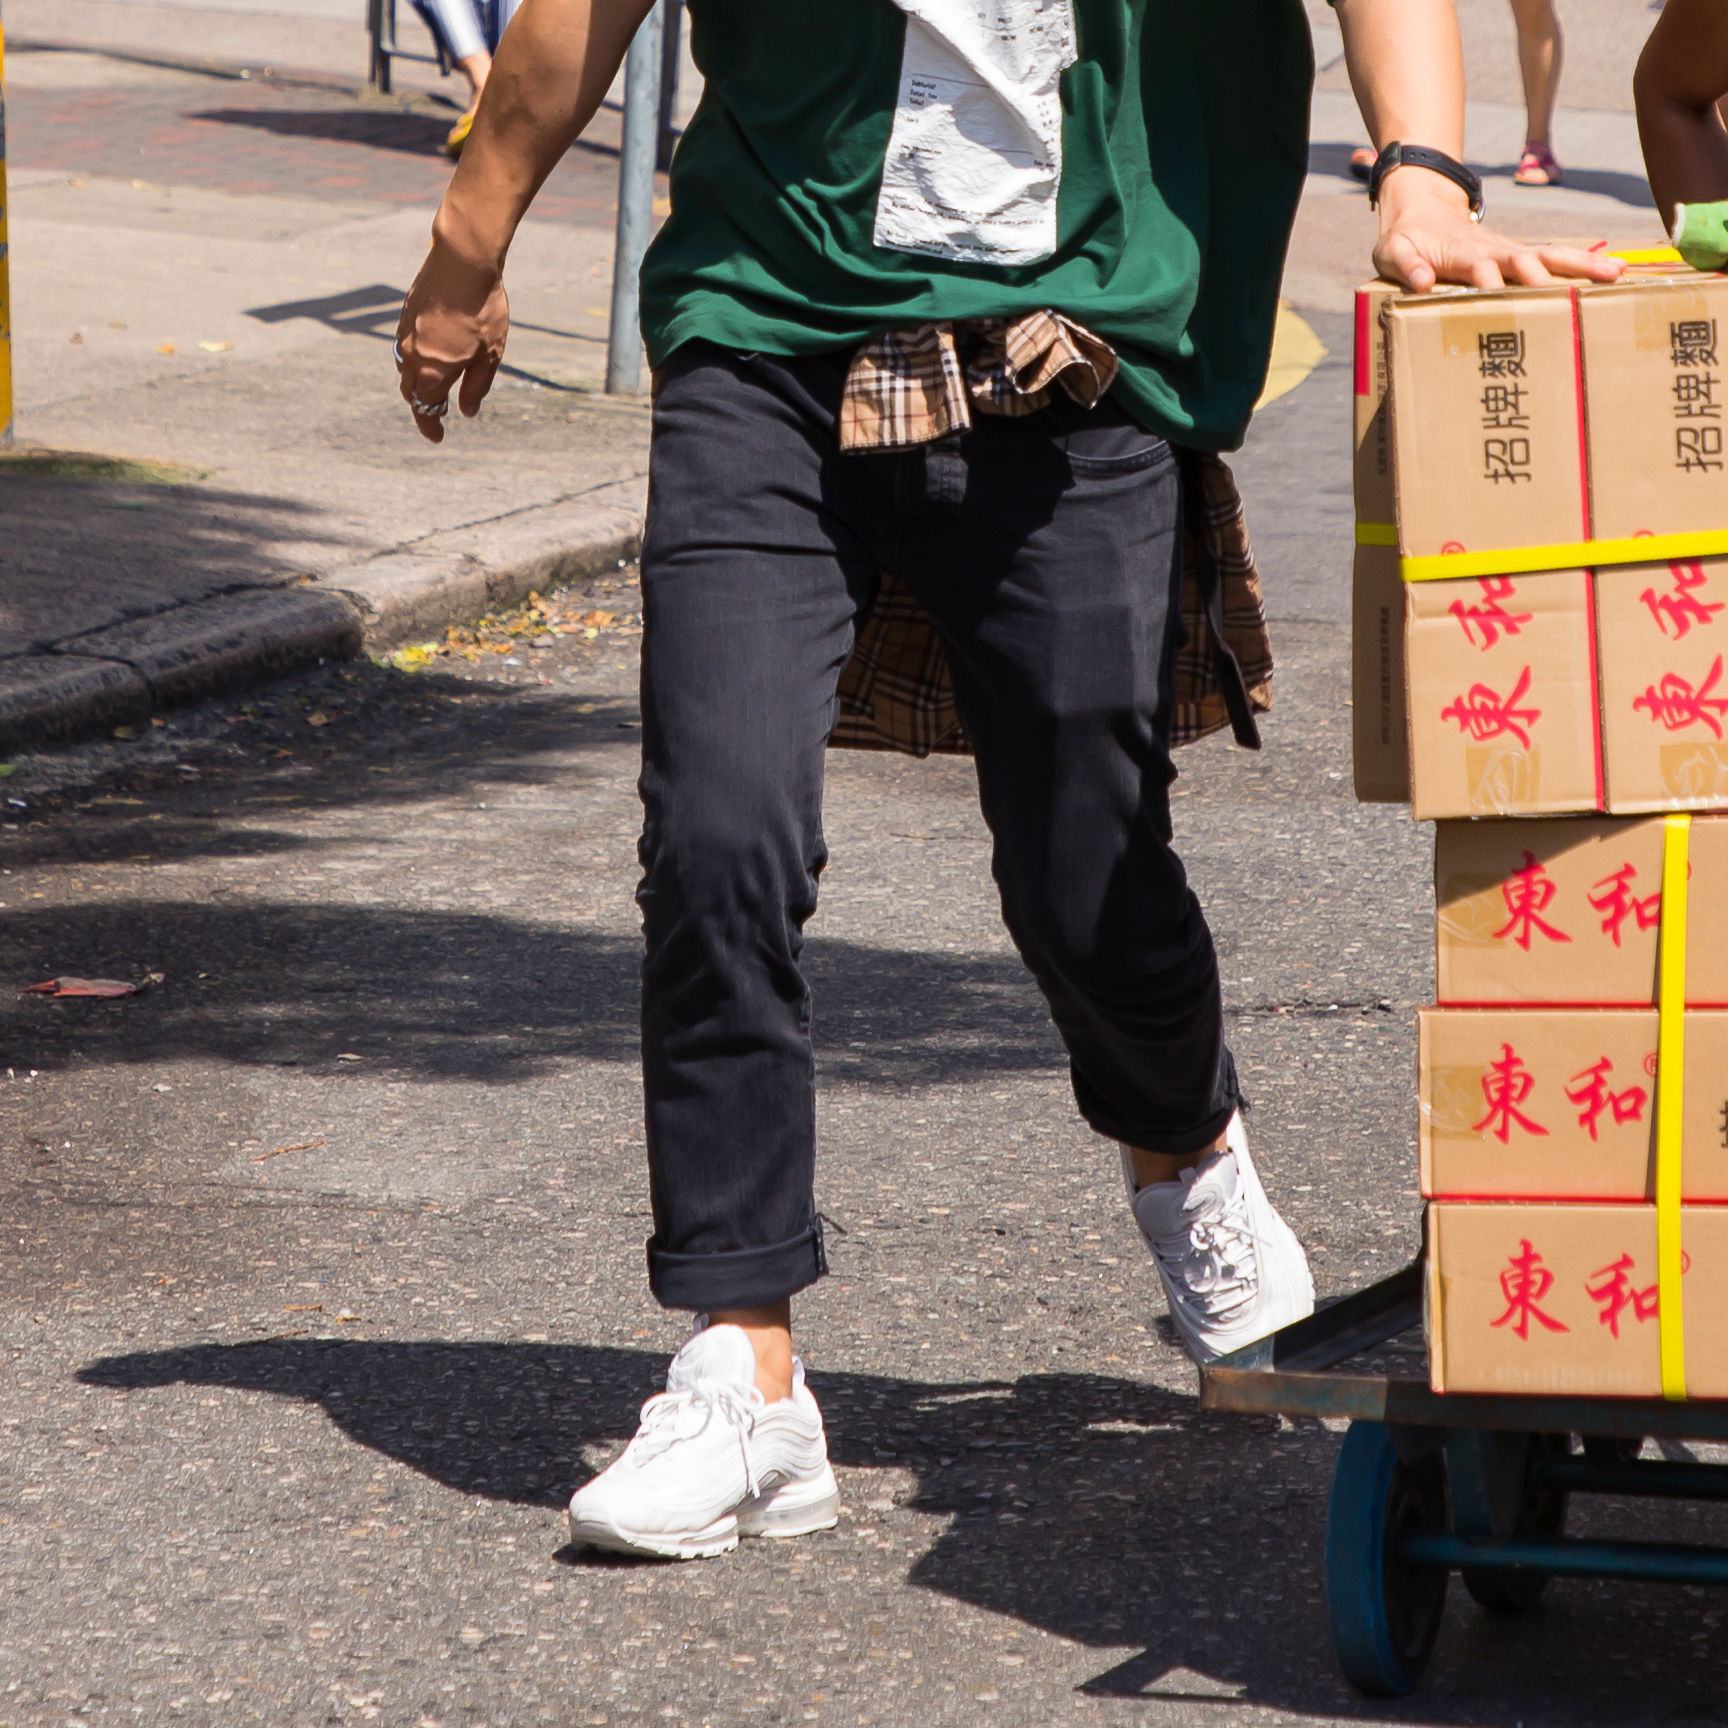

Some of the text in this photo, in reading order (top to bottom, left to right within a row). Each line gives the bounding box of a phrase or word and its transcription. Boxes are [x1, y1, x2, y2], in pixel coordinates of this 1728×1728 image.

[1478, 329, 1532, 486] 招牌麵
[1668, 318, 1724, 474] 招牌麵
[1440, 574, 1543, 751] 東和
[1491, 851, 1661, 951] 東和
[1472, 1043, 1647, 1145] 東和
[1490, 1237, 1659, 1341] 東和
